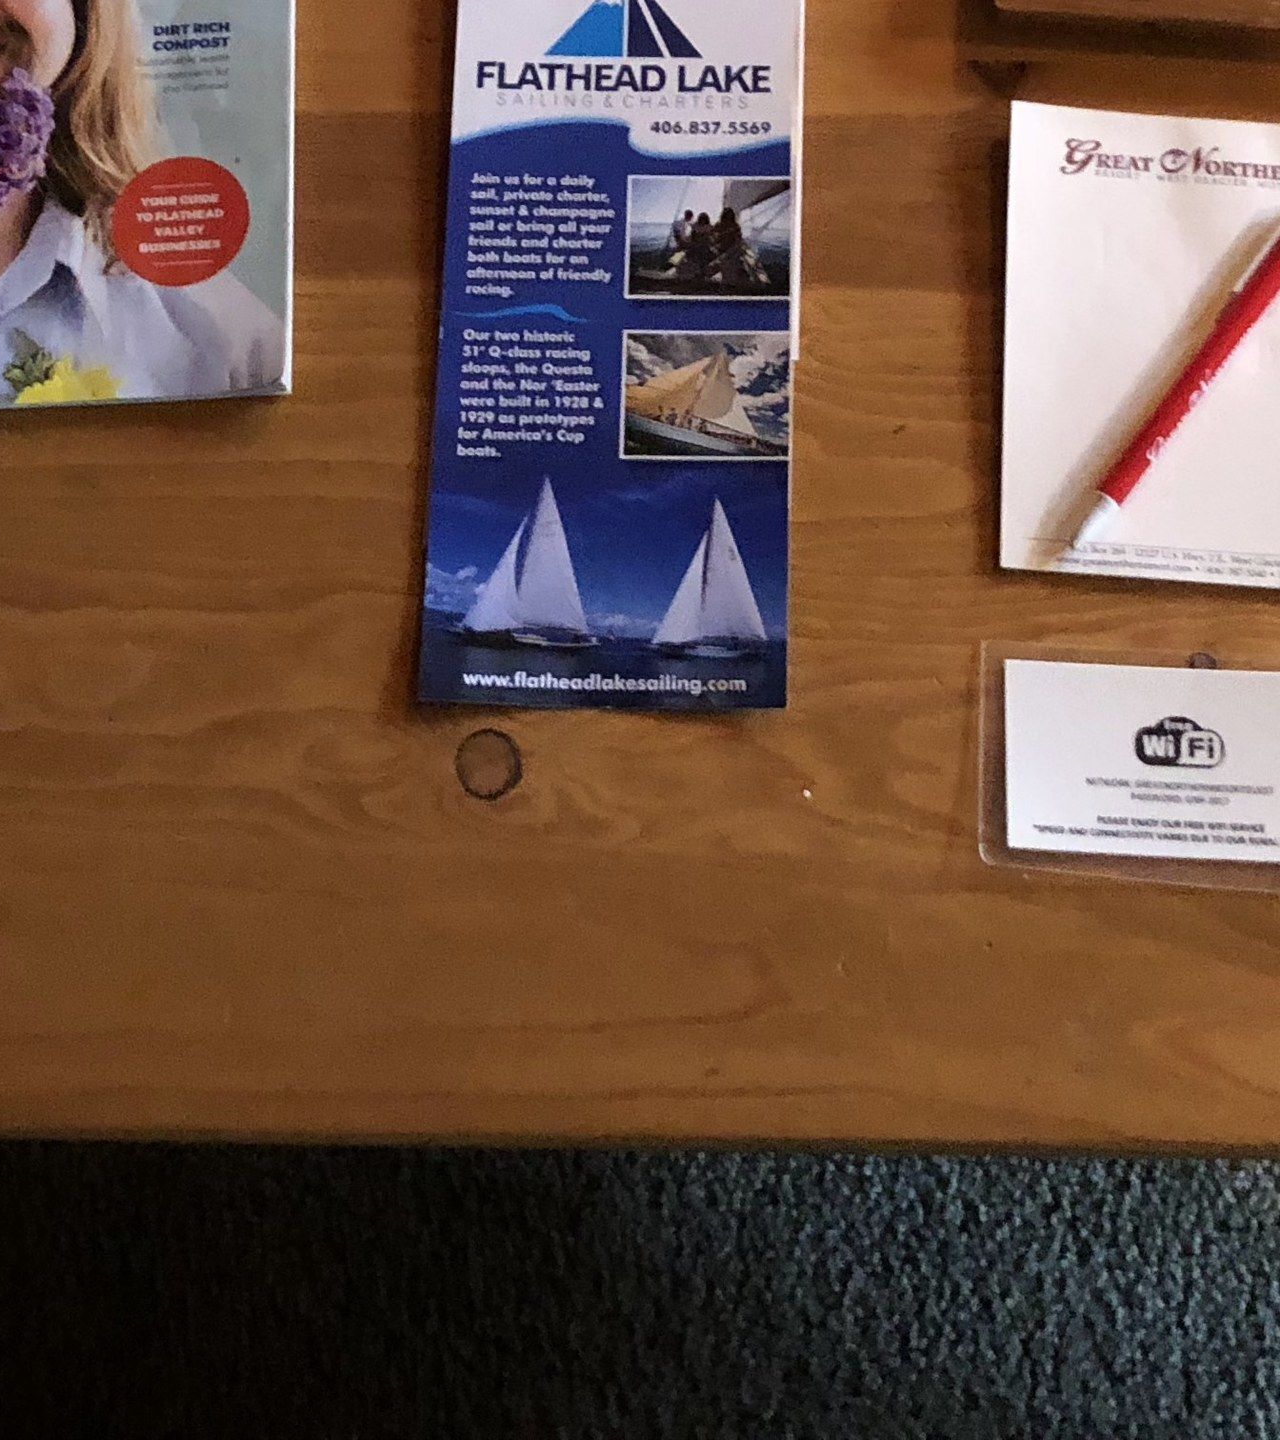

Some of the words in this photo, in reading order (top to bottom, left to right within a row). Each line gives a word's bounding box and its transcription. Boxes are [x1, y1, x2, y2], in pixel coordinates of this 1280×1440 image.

[152, 24, 190, 36] DIRT
[192, 21, 231, 34] RICH
[152, 36, 230, 52] COMPOST
[476, 61, 666, 92] FLATHEAD
[677, 64, 771, 93] LAKE
[495, 92, 594, 108] SAILING
[603, 93, 613, 108] &
[622, 93, 751, 110] CHARTERS
[650, 120, 772, 136] 406.837.5569
[1059, 137, 1154, 175] GREAT
[471, 172, 500, 184] Join
[504, 175, 520, 185] us
[522, 173, 544, 185] for
[546, 176, 557, 185] a
[560, 174, 596, 189] daily
[140, 196, 178, 207] YOUR
[503, 190, 553, 202] private
[136, 212, 153, 222] TO
[155, 208, 224, 221] FLATHEAD
[469, 205, 515, 216] sunset
[518, 205, 529, 216] &
[533, 205, 616, 220] champagne
[153, 224, 205, 237] VALLEY
[468, 219, 494, 232] sail
[497, 222, 514, 232] or
[516, 220, 555, 235] bring
[558, 221, 577, 233] all
[580, 224, 611, 236] your
[138, 239, 221, 253] BUSINESSES
[467, 234, 517, 247] friends
[520, 237, 549, 248] and
[553, 238, 603, 249] charter
[467, 250, 499, 263] both
[503, 251, 542, 264] boats
[546, 252, 564, 264] for
[569, 255, 589, 265] an
[466, 267, 536, 280] afternoon
[539, 268, 554, 280] of
[557, 268, 613, 284] friendly
[465, 282, 515, 298] racing.
[462, 328, 491, 341] Our
[494, 330, 520, 342] two
[523, 329, 575, 343] historic
[488, 345, 542, 358] Q-class
[545, 346, 591, 362] racing
[514, 362, 538, 375] the
[542, 362, 593, 376] Questa
[460, 379, 489, 390] and
[492, 378, 516, 390] the
[520, 380, 547, 391] Nor
[460, 397, 495, 407] were
[499, 395, 532, 407] built
[536, 396, 549, 408] in
[555, 396, 589, 409] 1928
[593, 396, 604, 409] &
[460, 410, 495, 423] 1929
[498, 414, 516, 424] as
[519, 414, 595, 428] prototypes
[457, 427, 479, 440] for
[482, 427, 553, 442] America's
[556, 429, 585, 444] Cup
[456, 442, 501, 457] boats.
[462, 671, 748, 696] www.flatheadlakesailing.com
